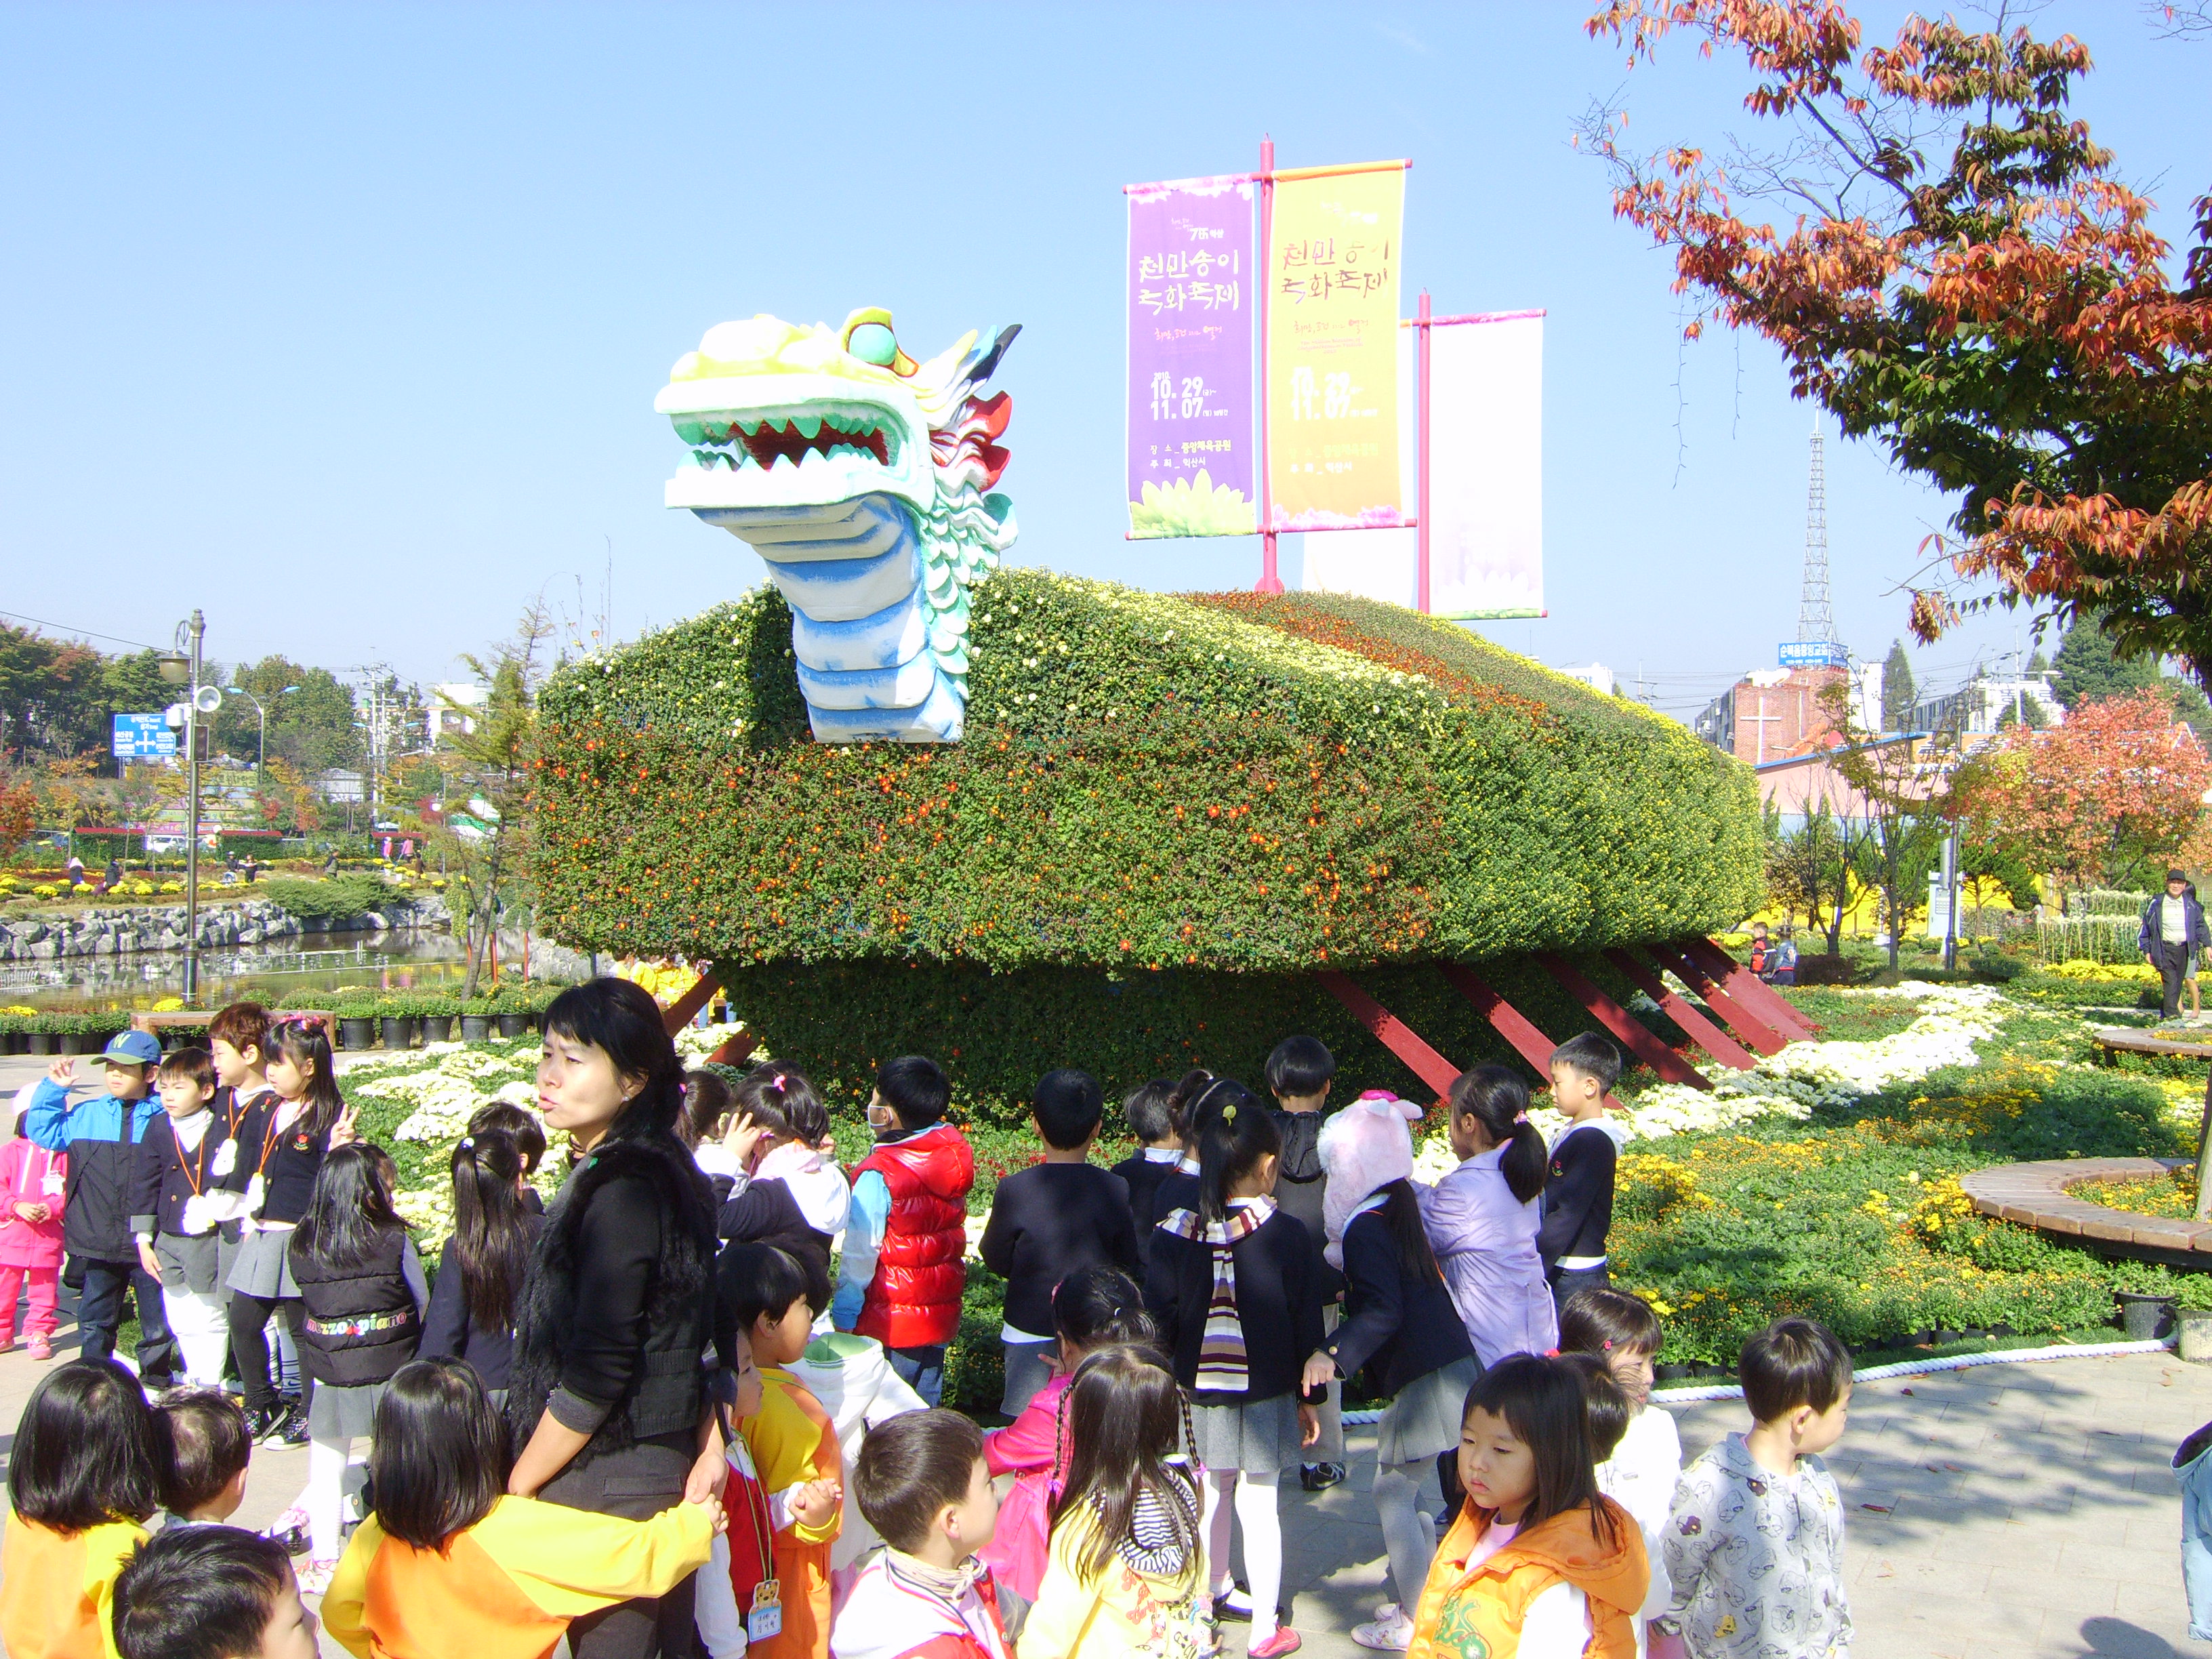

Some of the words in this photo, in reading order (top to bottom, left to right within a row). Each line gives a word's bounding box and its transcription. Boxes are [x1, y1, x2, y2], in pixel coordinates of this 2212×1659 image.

[1139, 249, 1239, 283] 천만송이
[1138, 280, 1240, 316] 국화축제
[1780, 642, 1828, 658] 순복음중앙교회
[306, 1318, 348, 1335] mezzo
[357, 1313, 407, 1336] piano
